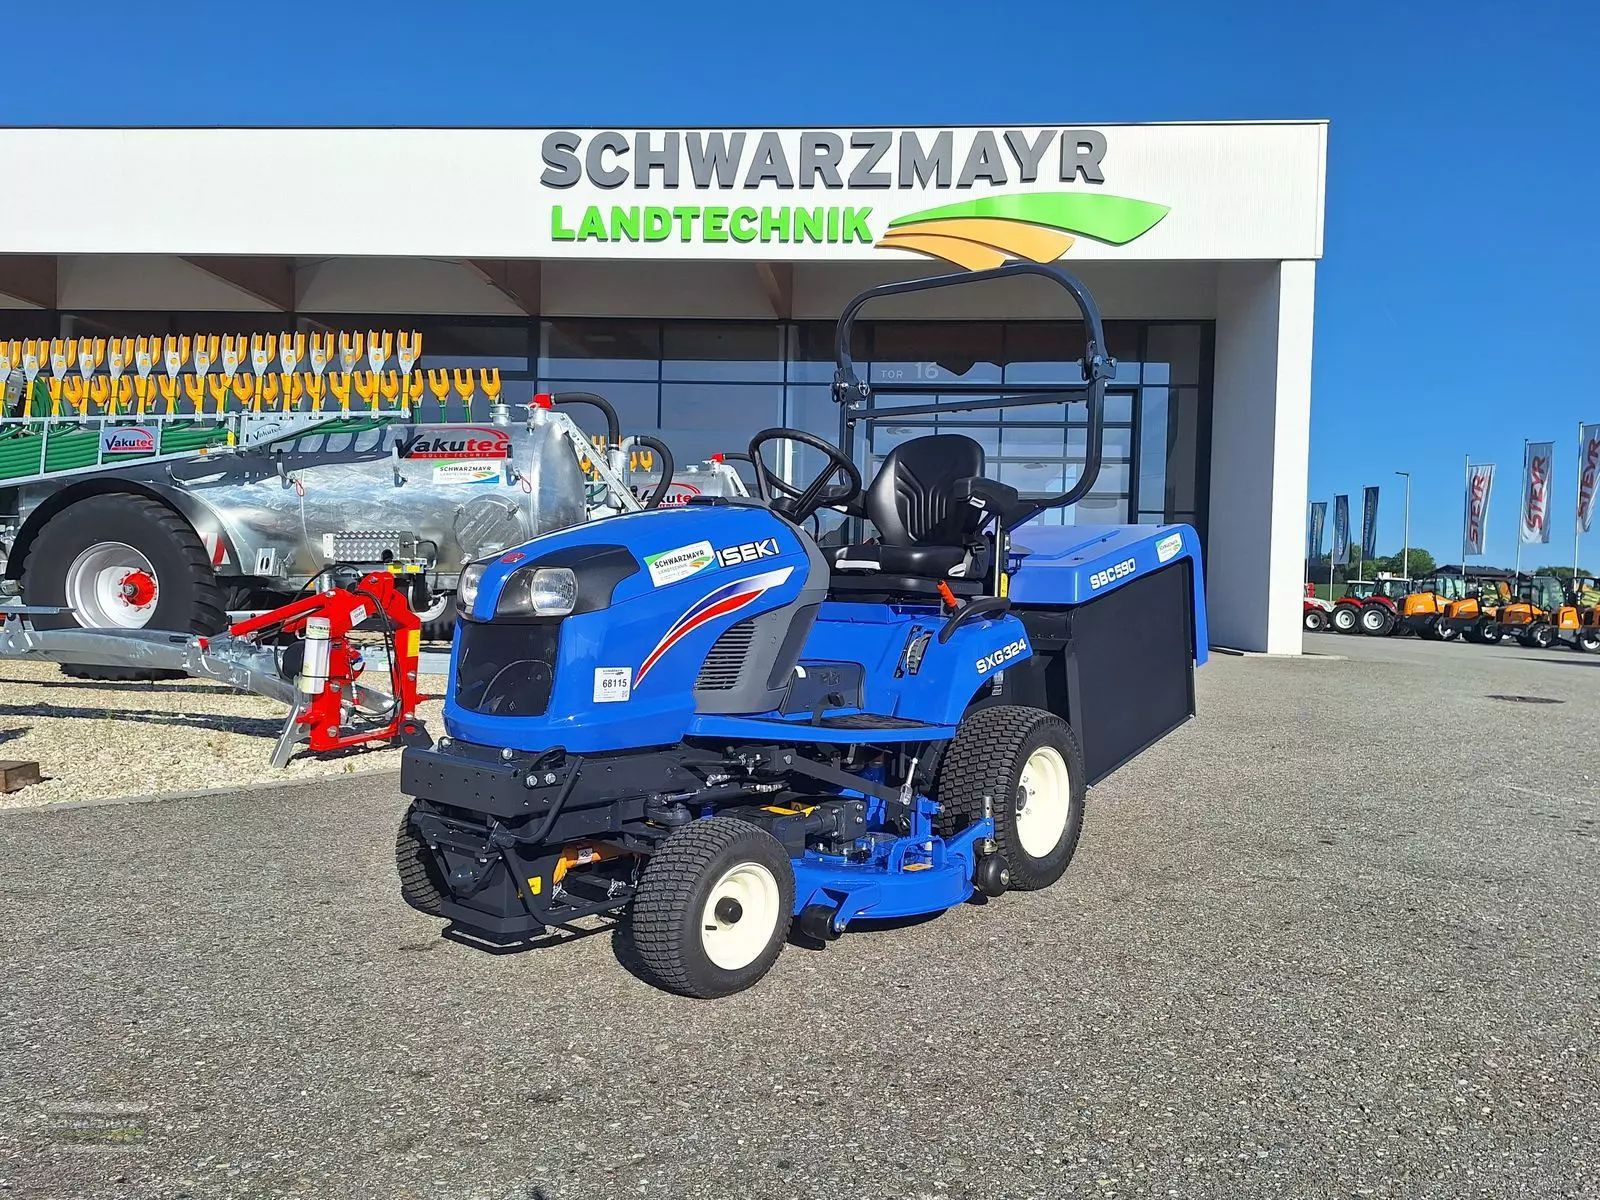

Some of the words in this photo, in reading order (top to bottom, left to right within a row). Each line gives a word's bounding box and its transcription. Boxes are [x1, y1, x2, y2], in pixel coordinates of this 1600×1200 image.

[540, 130, 1107, 190] SCHWARZMAYR
[551, 205, 873, 243] LANDTECHNIK
[881, 370, 903, 378] TOR
[915, 362, 939, 379] 16
[105, 435, 154, 451] Vakutec
[395, 434, 508, 459] Vakutec
[1525, 456, 1546, 531] STEYR
[1578, 438, 1600, 520] STEYR
[1469, 475, 1485, 544] STEYR
[654, 550, 704, 568] SCHWARZMAYR
[715, 538, 780, 567] ISEKI
[1089, 557, 1136, 591] SBC590
[975, 638, 1027, 674] SXG324
[602, 678, 627, 688] 68115
